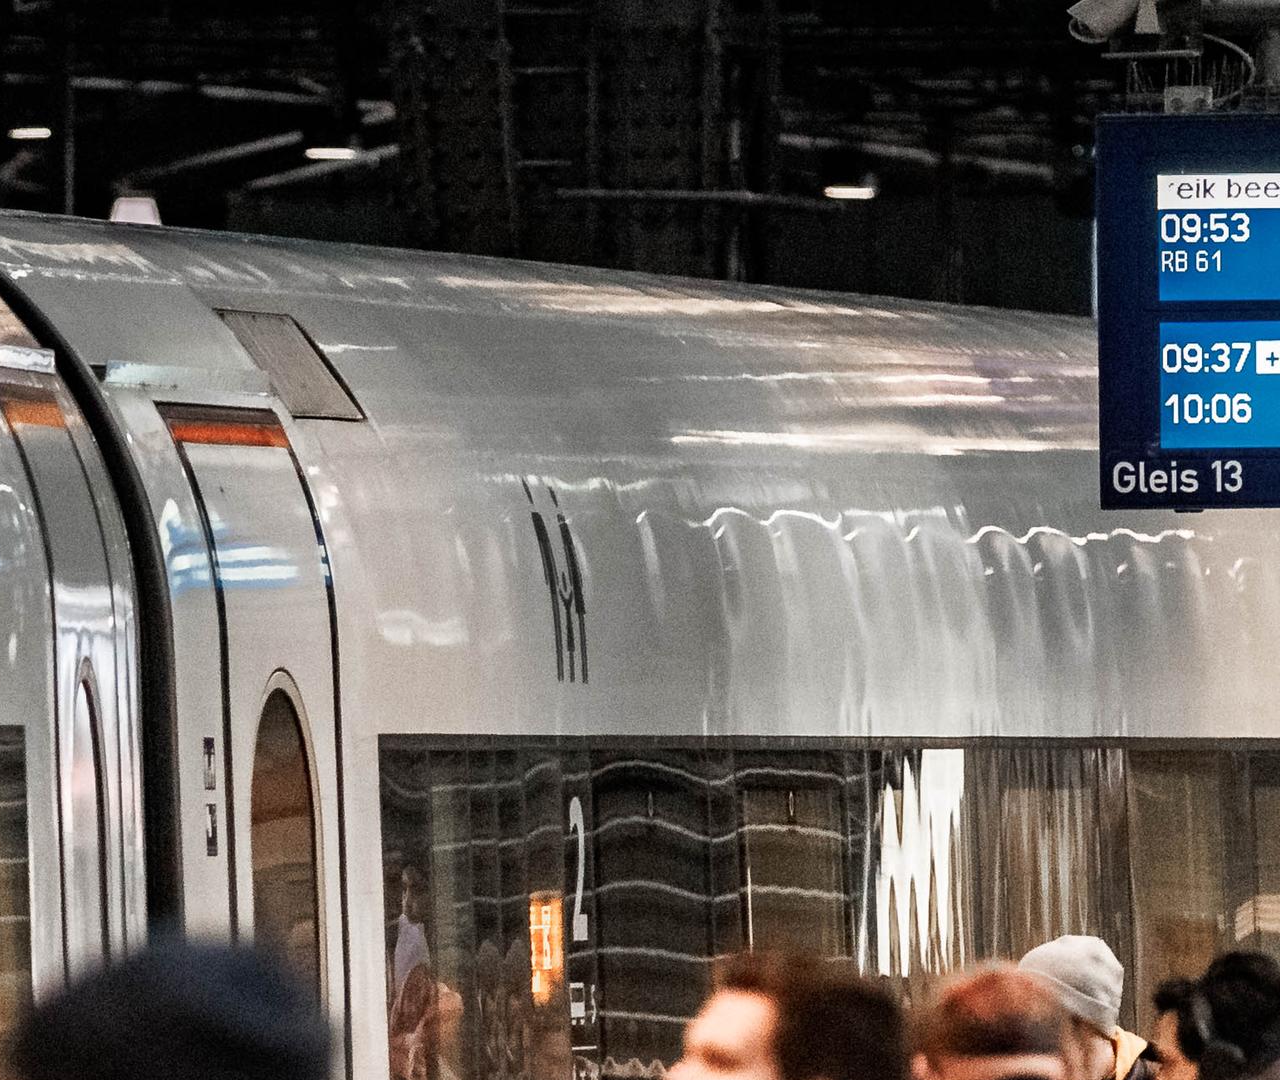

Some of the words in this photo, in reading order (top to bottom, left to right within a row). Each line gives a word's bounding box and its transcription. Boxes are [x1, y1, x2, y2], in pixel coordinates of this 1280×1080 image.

[1169, 178, 1215, 200] eik
[1160, 212, 1251, 244] 09:53
[1160, 250, 1188, 273] RB
[1195, 250, 1223, 273] 61
[1161, 342, 1252, 374] 09:37
[1165, 393, 1252, 425] 10:06
[1112, 460, 1200, 494] Gleis
[1210, 460, 1244, 493] 13
[570, 796, 589, 942] 2
